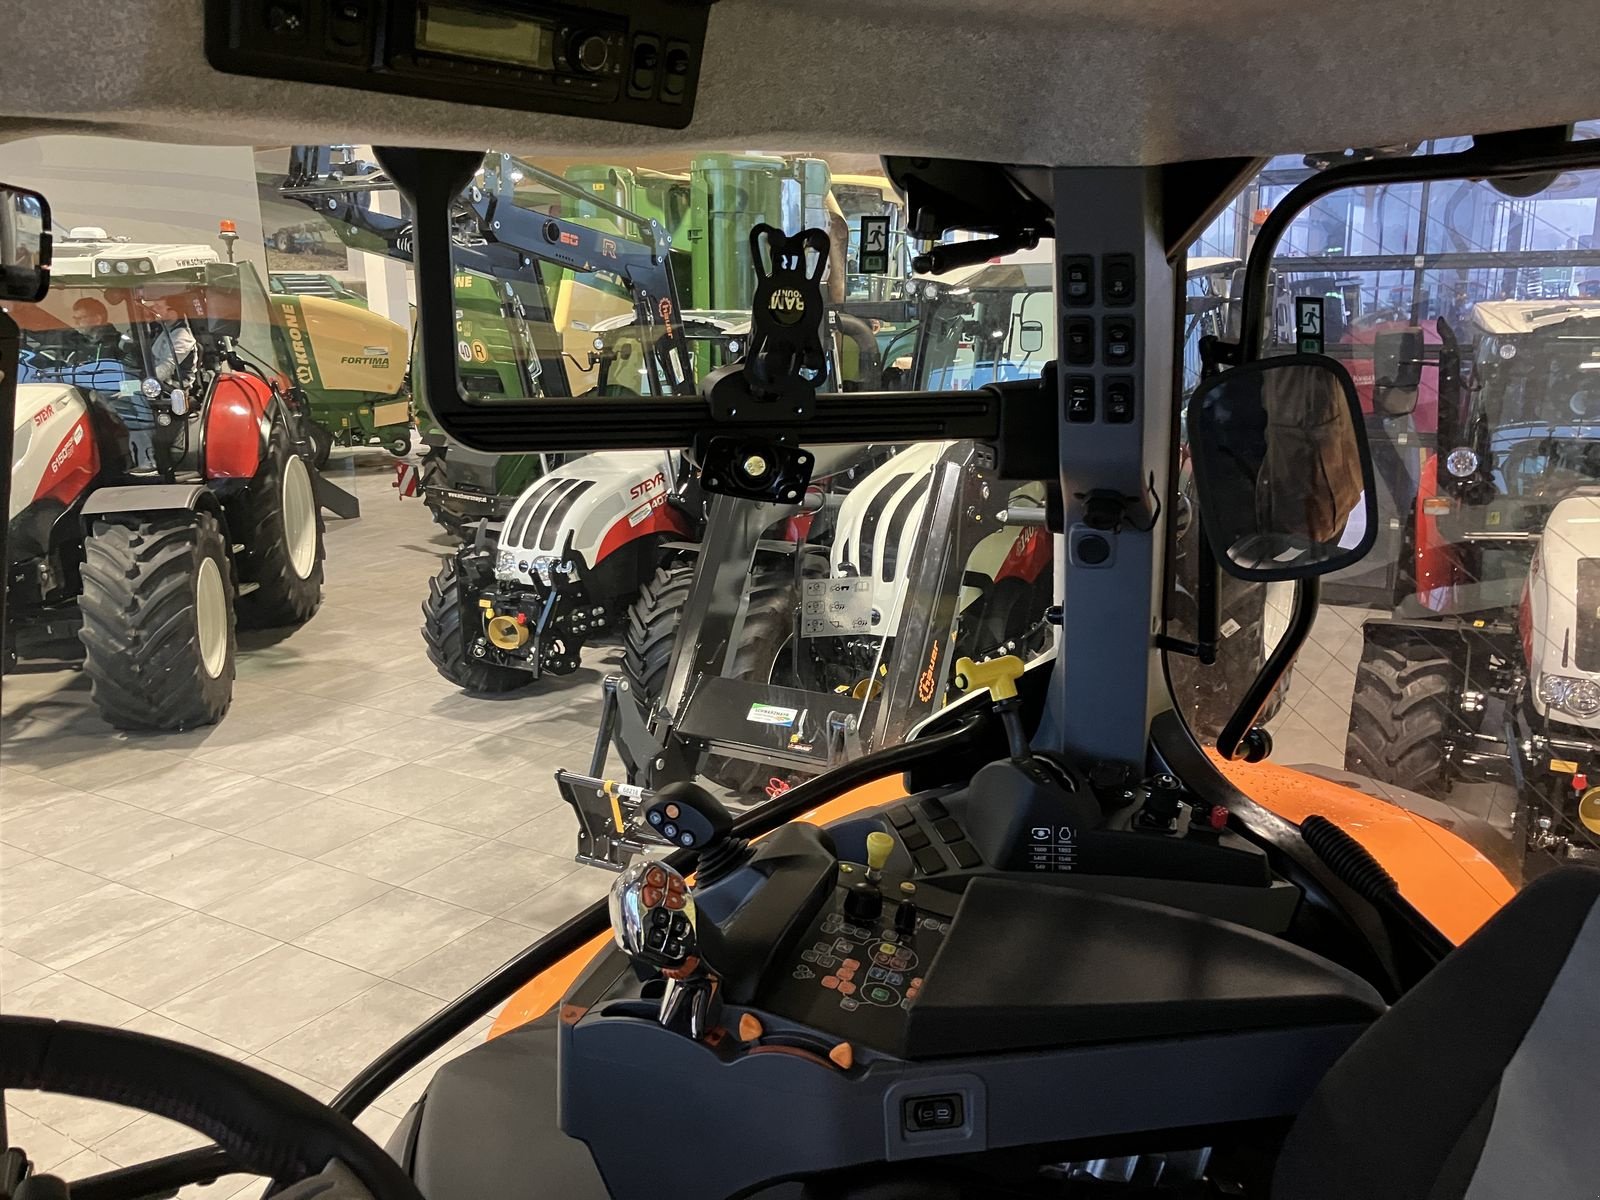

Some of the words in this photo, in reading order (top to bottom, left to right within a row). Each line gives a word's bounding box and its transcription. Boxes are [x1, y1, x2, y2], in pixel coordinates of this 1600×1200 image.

[454, 276, 473, 288] NE
[770, 297, 805, 310] RAM
[281, 303, 309, 365] KRONE
[459, 343, 471, 359] 40
[474, 344, 484, 358] R
[340, 356, 390, 365] FORTIMA
[33, 404, 55, 428] STEYR
[630, 472, 666, 500] STEYR
